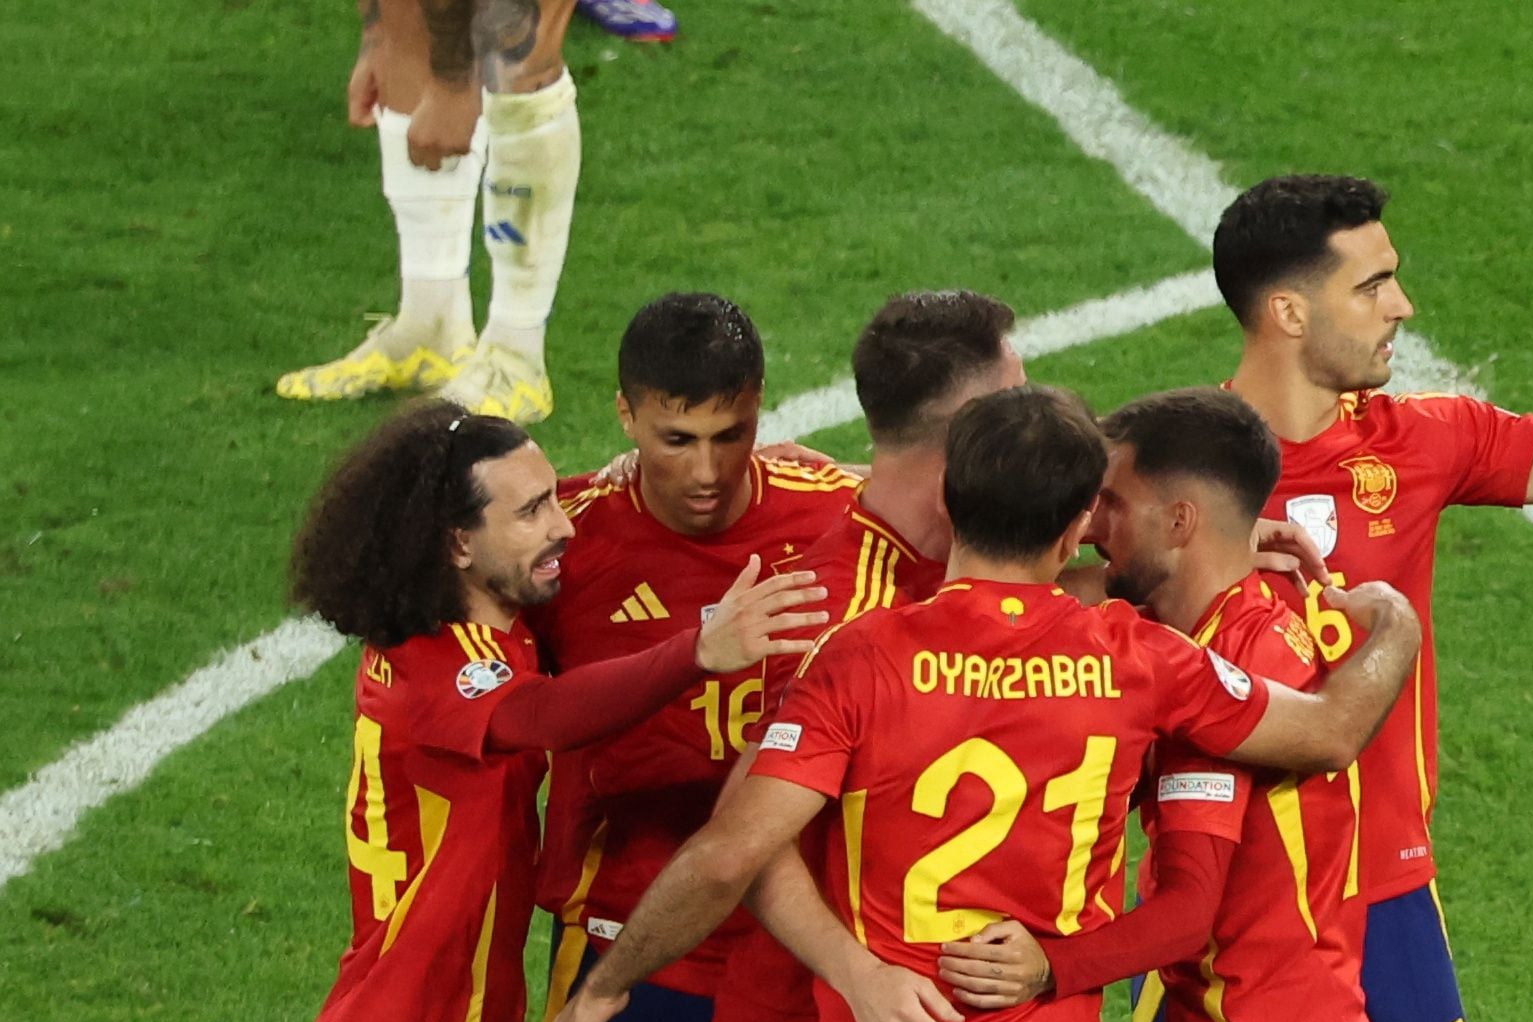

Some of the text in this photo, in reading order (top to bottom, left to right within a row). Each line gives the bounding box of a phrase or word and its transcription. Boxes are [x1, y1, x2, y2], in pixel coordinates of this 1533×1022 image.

[1305, 571, 1353, 662] 6
[913, 650, 1121, 699] OYARZABAL
[904, 735, 1117, 944] 21
